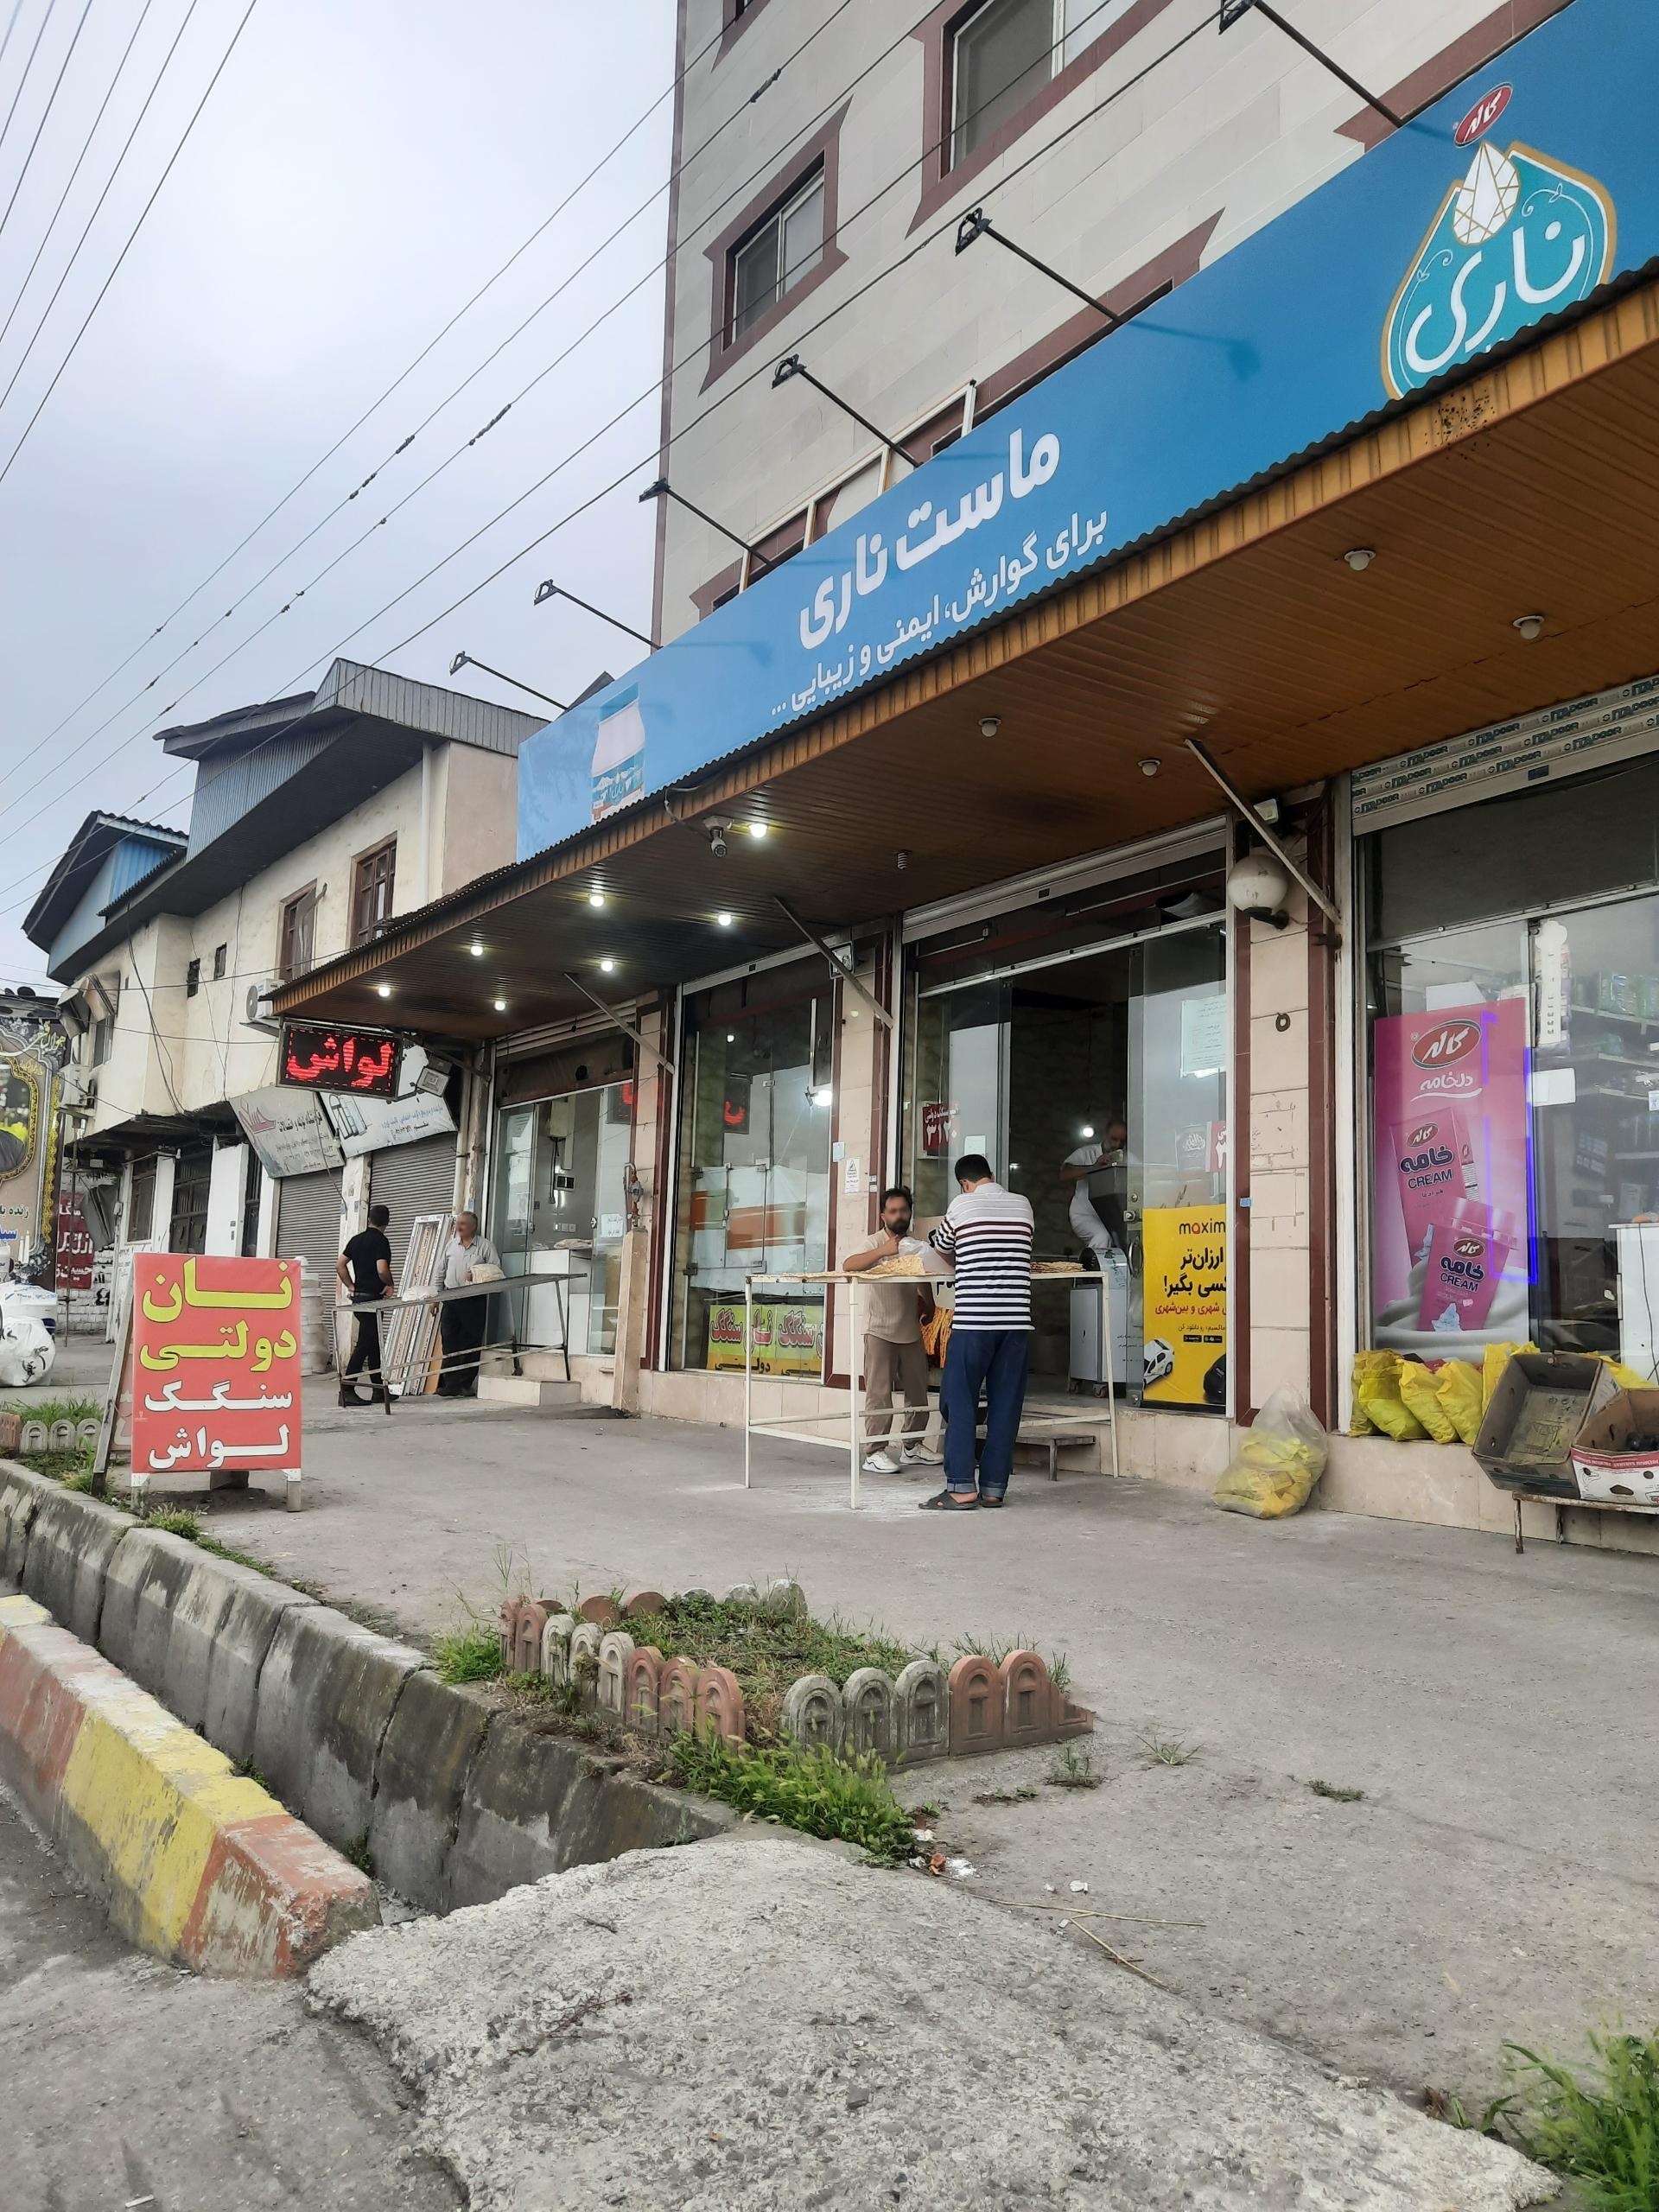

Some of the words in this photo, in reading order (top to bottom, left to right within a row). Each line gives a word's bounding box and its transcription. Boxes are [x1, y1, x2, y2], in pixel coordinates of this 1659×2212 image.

[895, 427, 1061, 572] ماست
[1046, 511, 1108, 571] برای
[799, 532, 889, 650] ناری
[944, 530, 1039, 623] گوارش،
[876, 594, 940, 664] ایمنی
[791, 644, 855, 713] زیبایی
[859, 644, 872, 677] و
[286, 1036, 393, 1088] لواش
[1400, 1145, 1455, 1174] خامه
[1408, 1169, 1453, 1190] CREAM
[1179, 1217, 1226, 1235] maxim
[142, 1256, 294, 1323] نان
[1163, 1272, 1193, 1298] بگیر!
[1440, 1255, 1485, 1281] خامه
[1440, 1273, 1480, 1293] CREAM
[140, 1319, 297, 1372] دولتی
[710, 1307, 744, 1344] سنگک
[778, 1309, 815, 1348] سنگک
[144, 1380, 294, 1412] سنگک
[148, 1423, 290, 1470] لواش
